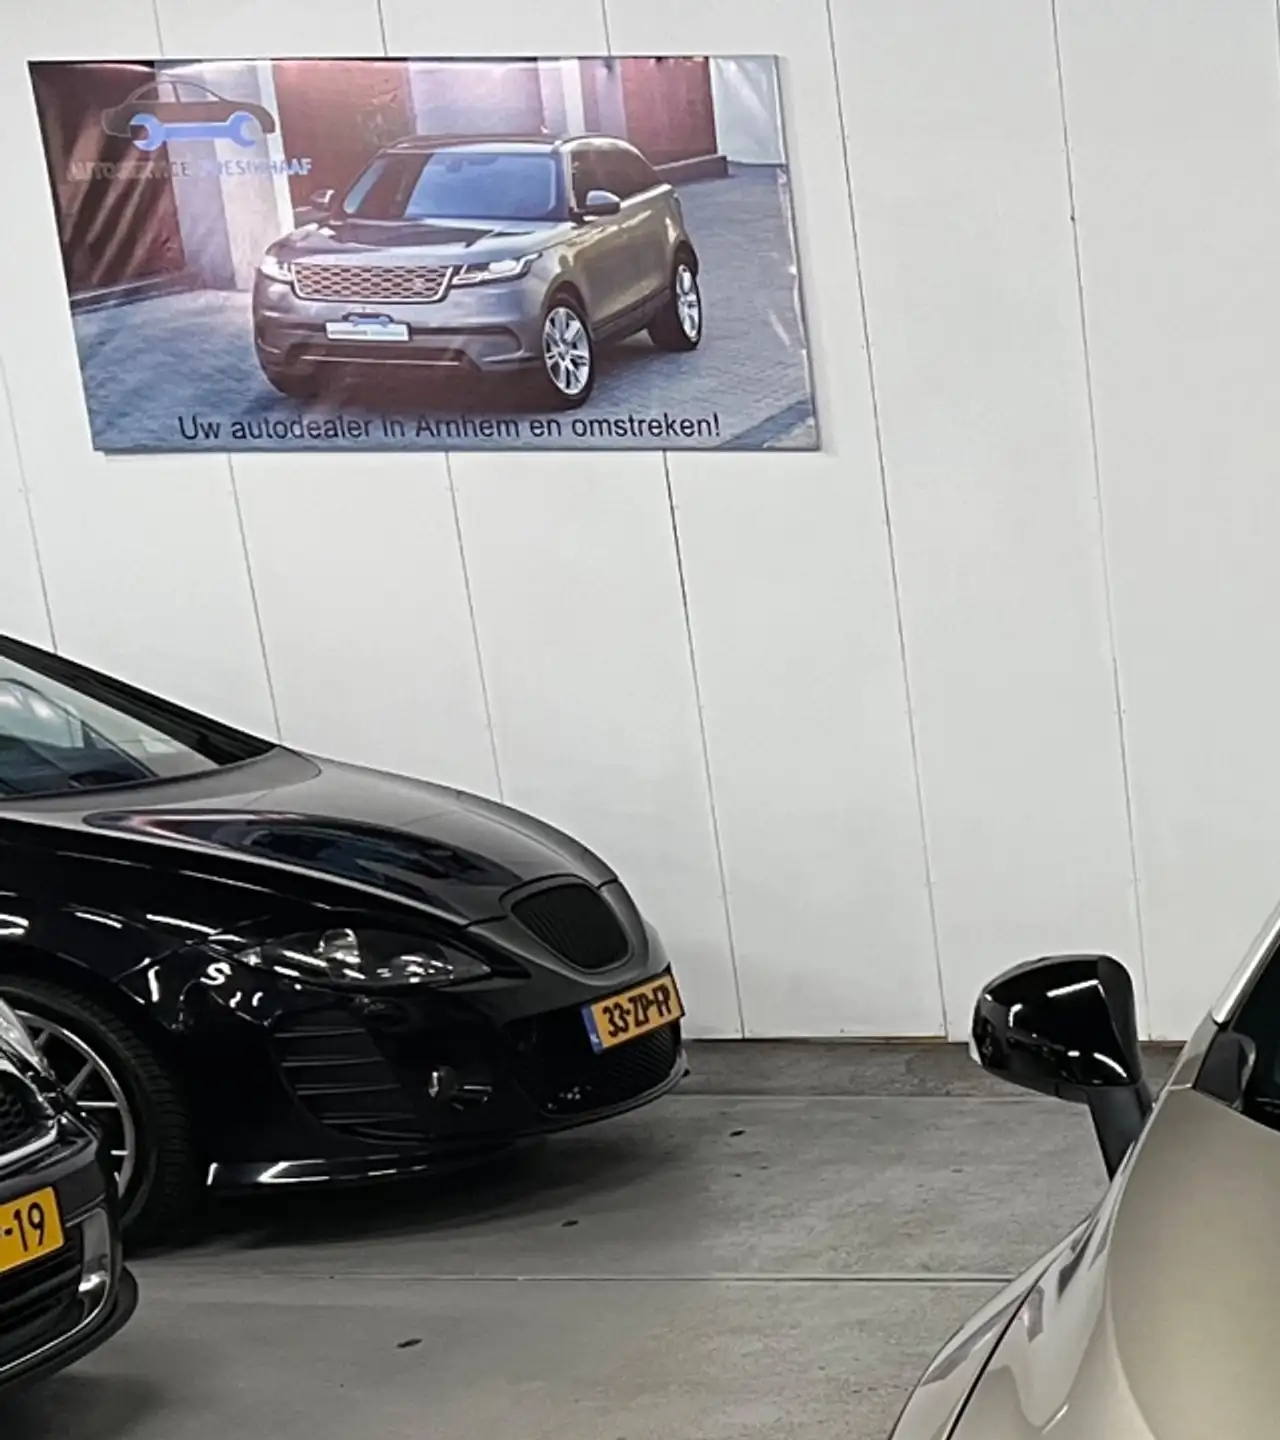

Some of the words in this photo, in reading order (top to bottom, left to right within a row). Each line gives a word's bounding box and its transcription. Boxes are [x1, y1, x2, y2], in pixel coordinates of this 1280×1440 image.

[178, 415, 221, 440] Uw
[231, 413, 372, 440] autodealer
[382, 414, 405, 438] in
[416, 413, 519, 438] Arnhem
[530, 418, 561, 437] en
[571, 411, 721, 438] omstreken!
